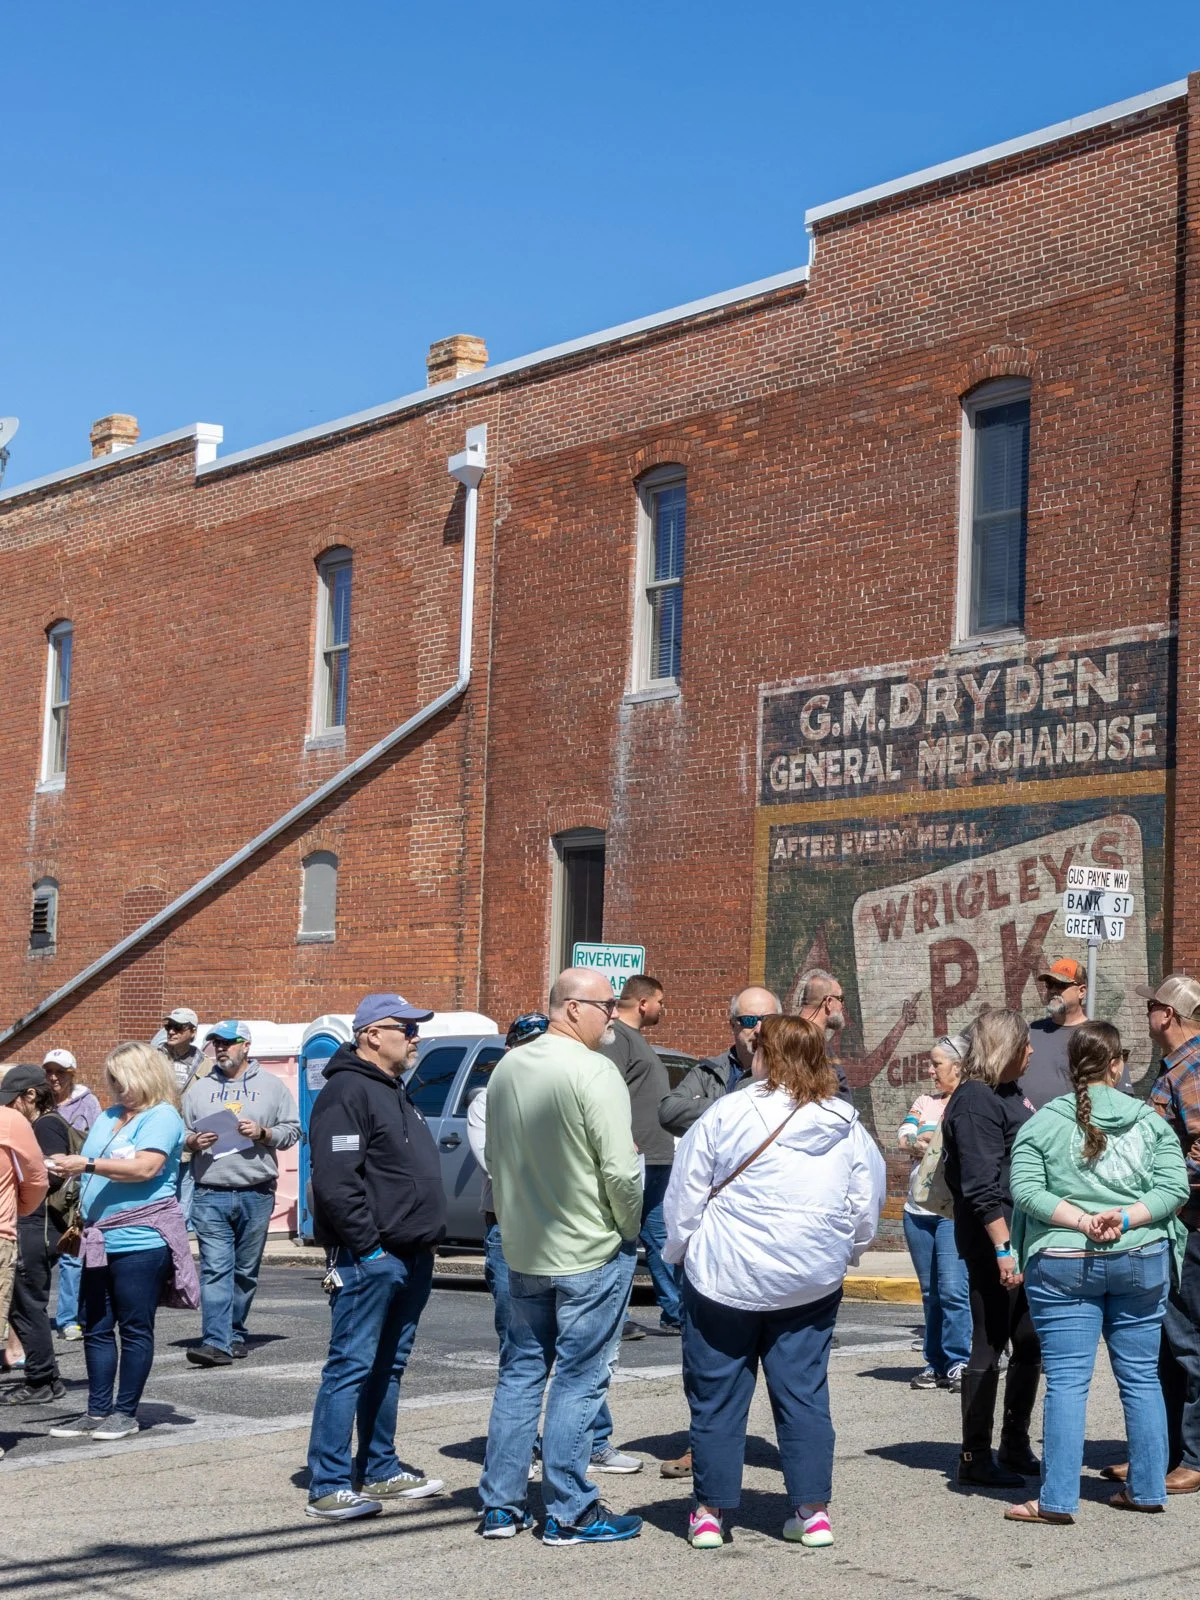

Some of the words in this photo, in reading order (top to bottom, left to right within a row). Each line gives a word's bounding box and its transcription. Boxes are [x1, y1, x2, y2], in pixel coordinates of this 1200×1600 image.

[769, 743, 901, 792] GENERAL
[918, 713, 1158, 778] MERCHANDISE
[773, 833, 836, 860] AFTER
[841, 828, 911, 854] EVERY
[870, 831, 1124, 942] WRIGLEY'S
[1068, 868, 1084, 885] GUS
[1087, 870, 1111, 888] PAYNE
[1114, 872, 1129, 889] WAY
[1067, 893, 1101, 911] BANK
[1113, 897, 1130, 914] ST
[1066, 918, 1101, 936] GREEN
[1110, 921, 1124, 937] ST
[576, 951, 641, 969] RIVERVIEW
[609, 976, 627, 991] AR
[210, 1090, 260, 1103] PITT
